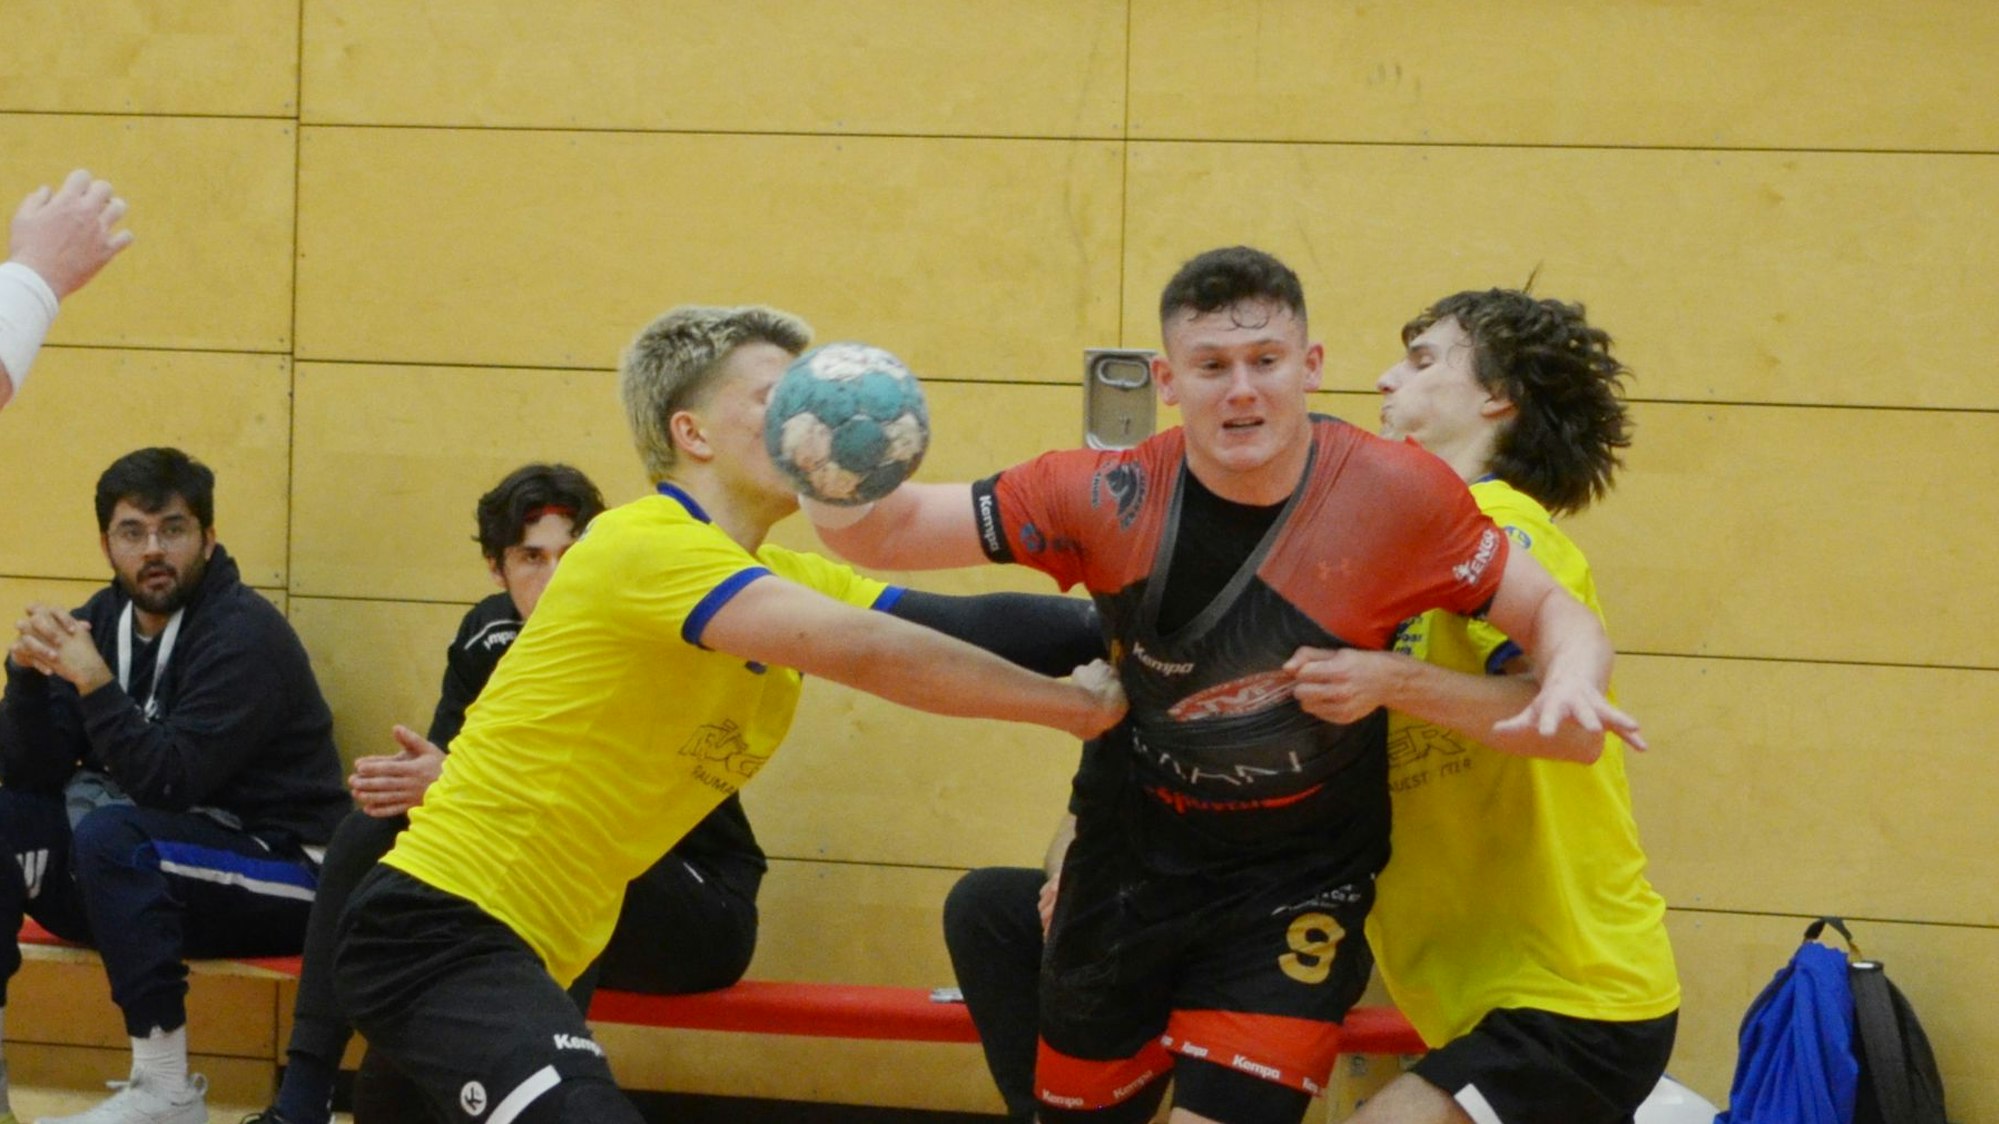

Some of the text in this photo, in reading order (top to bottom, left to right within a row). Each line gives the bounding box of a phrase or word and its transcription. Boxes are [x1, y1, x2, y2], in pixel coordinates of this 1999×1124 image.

[978, 494, 1001, 552] Kempa
[1132, 640, 1195, 676] Kempa
[1278, 912, 1346, 985] 9
[1231, 1054, 1282, 1081] Kempa
[1042, 1088, 1085, 1109] Kempa
